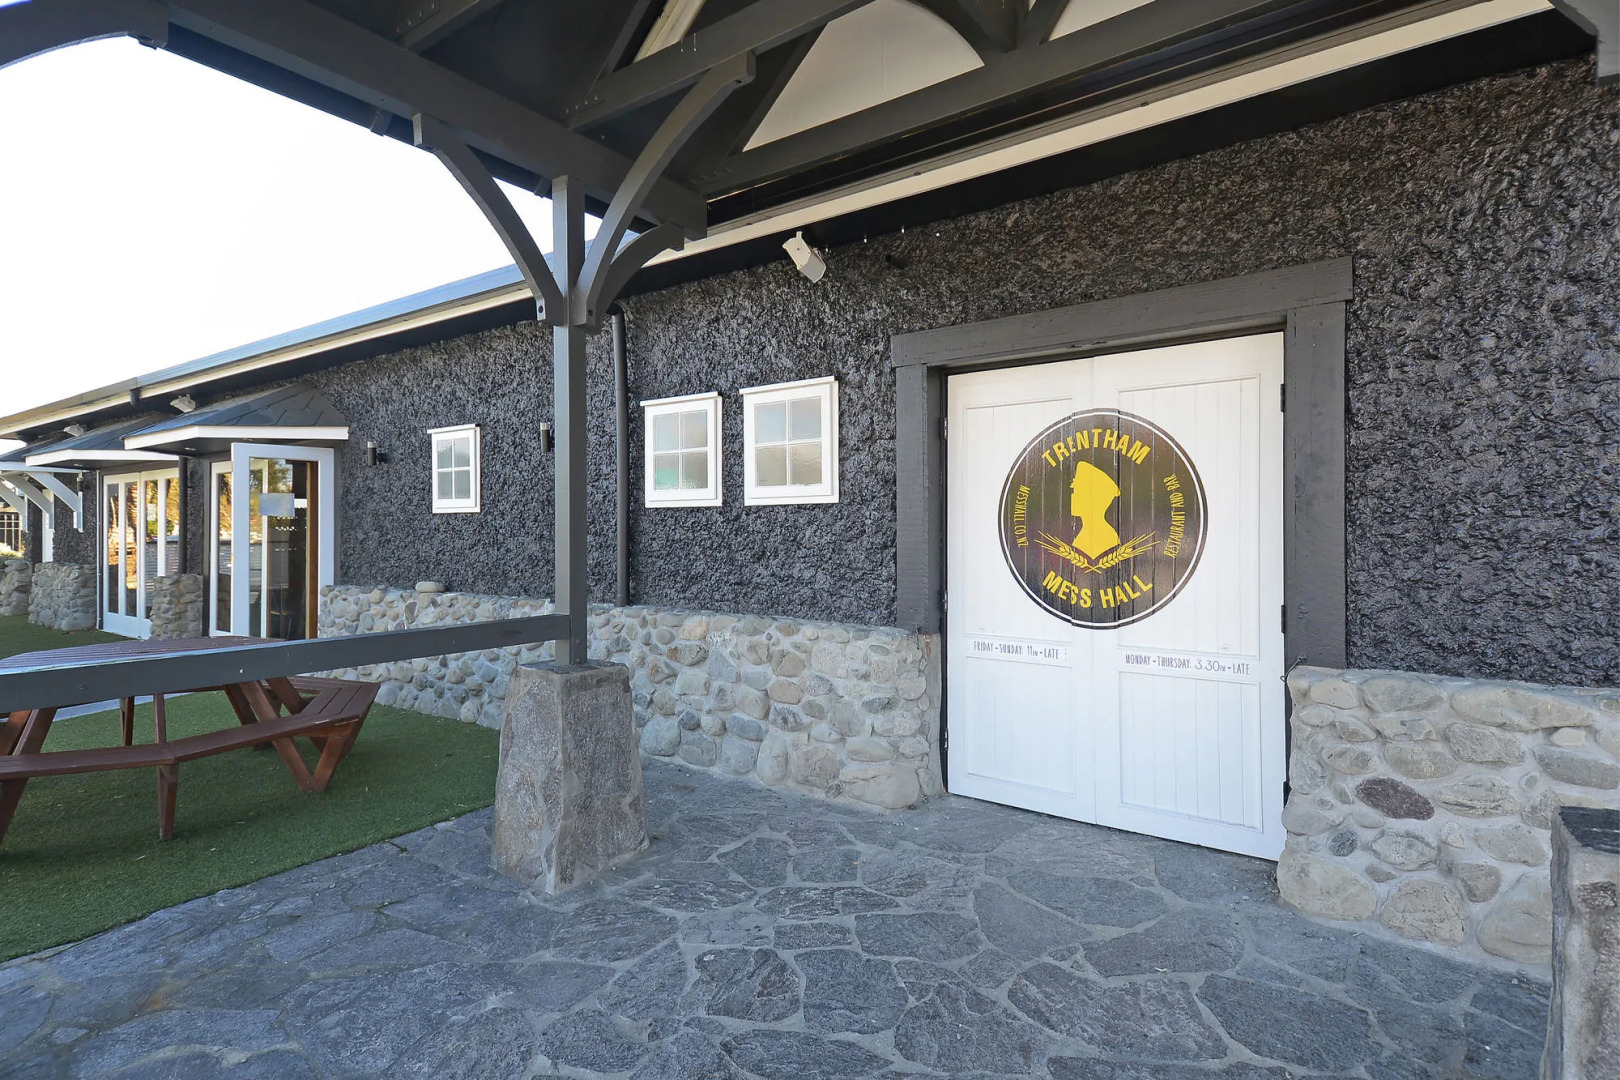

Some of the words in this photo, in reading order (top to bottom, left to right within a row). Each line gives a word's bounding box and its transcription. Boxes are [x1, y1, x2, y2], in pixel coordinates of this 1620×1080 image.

[1041, 428, 1151, 468] TRENTHAM
[1163, 473, 1180, 491] BAR
[1169, 492, 1185, 508] AND
[1163, 510, 1186, 558] RESTAURANT
[1042, 570, 1092, 608] MESS
[1100, 575, 1153, 609] HALL
